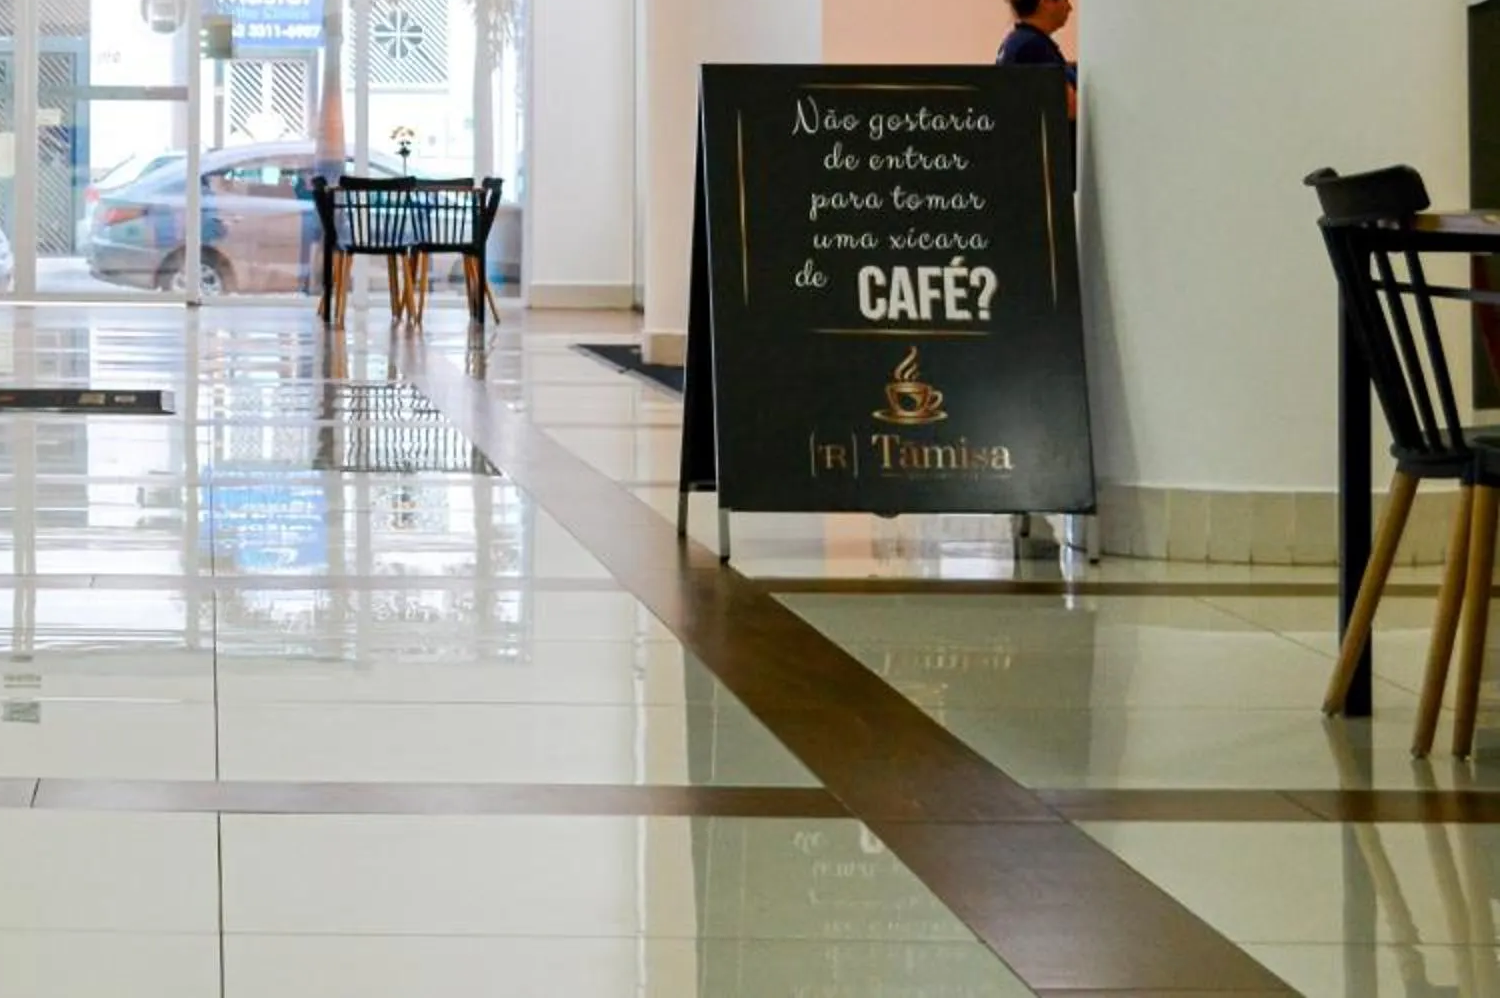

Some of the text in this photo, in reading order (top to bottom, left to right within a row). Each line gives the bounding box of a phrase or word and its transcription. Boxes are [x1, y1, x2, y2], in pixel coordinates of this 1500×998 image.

[791, 95, 996, 140] Não gostaria
[823, 141, 969, 170] de entrar
[809, 185, 987, 221] para tomar
[813, 231, 879, 250] uma
[795, 255, 999, 321] de CAFÉ?
[871, 433, 1016, 470] Tamisa
